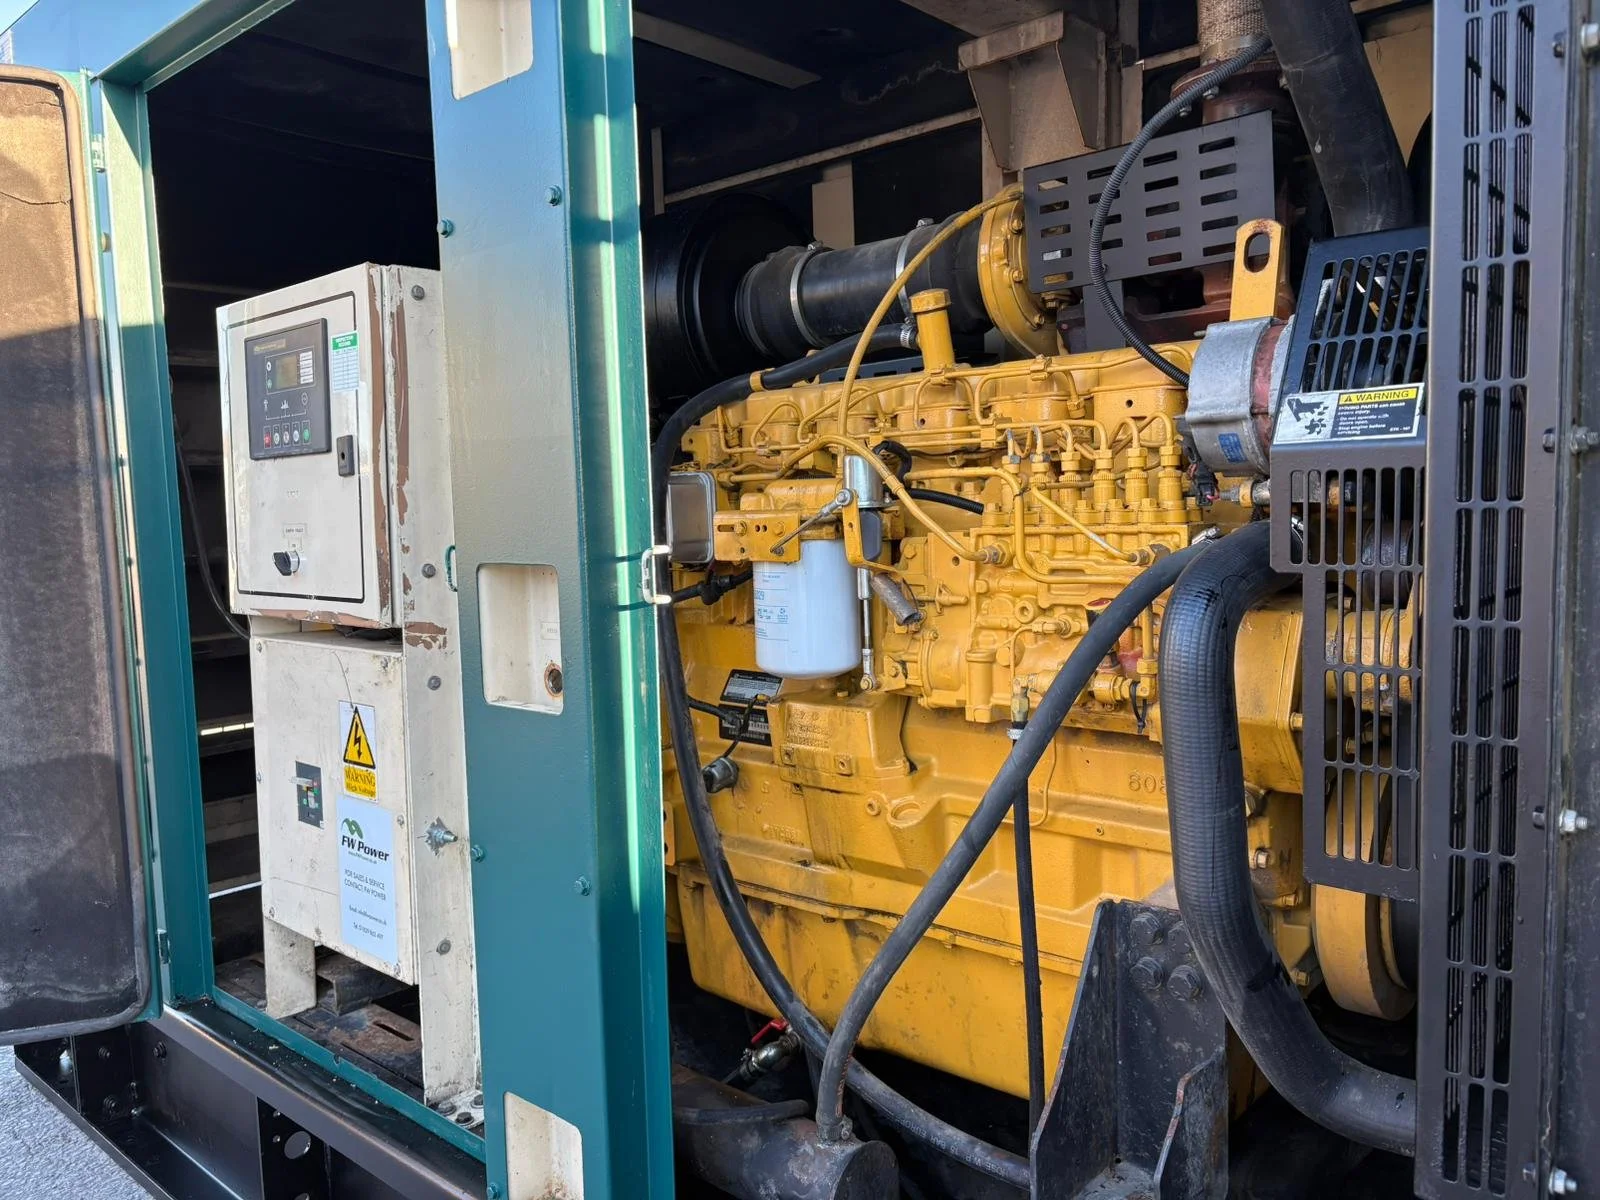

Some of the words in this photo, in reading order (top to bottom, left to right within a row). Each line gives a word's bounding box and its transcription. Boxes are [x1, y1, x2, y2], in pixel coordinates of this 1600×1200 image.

[1356, 390, 1409, 401] WARNING
[344, 769, 376, 787] WARNING
[341, 835, 356, 850] FW
[357, 840, 390, 862] Power
